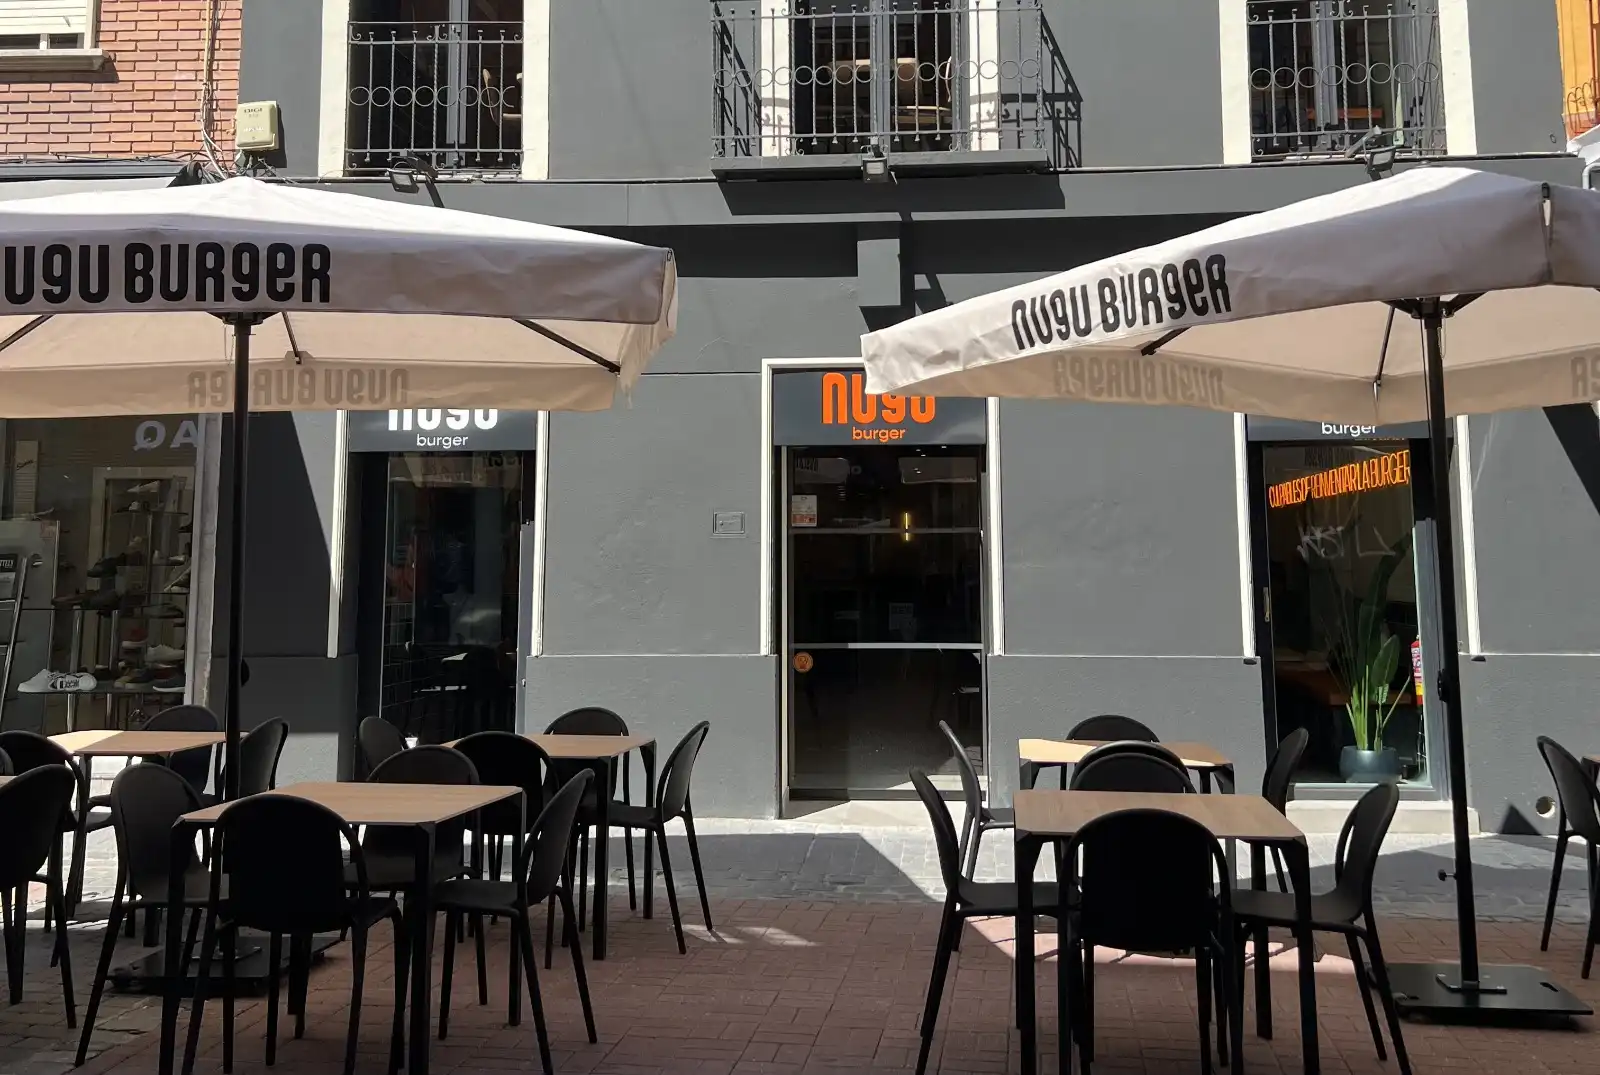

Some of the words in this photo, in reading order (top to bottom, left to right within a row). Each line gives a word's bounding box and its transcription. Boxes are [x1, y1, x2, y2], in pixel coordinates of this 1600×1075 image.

[852, 426, 906, 442] burger
[1321, 421, 1376, 437] burger
[416, 433, 469, 449] burger
[1370, 449, 1411, 488] BURGER
